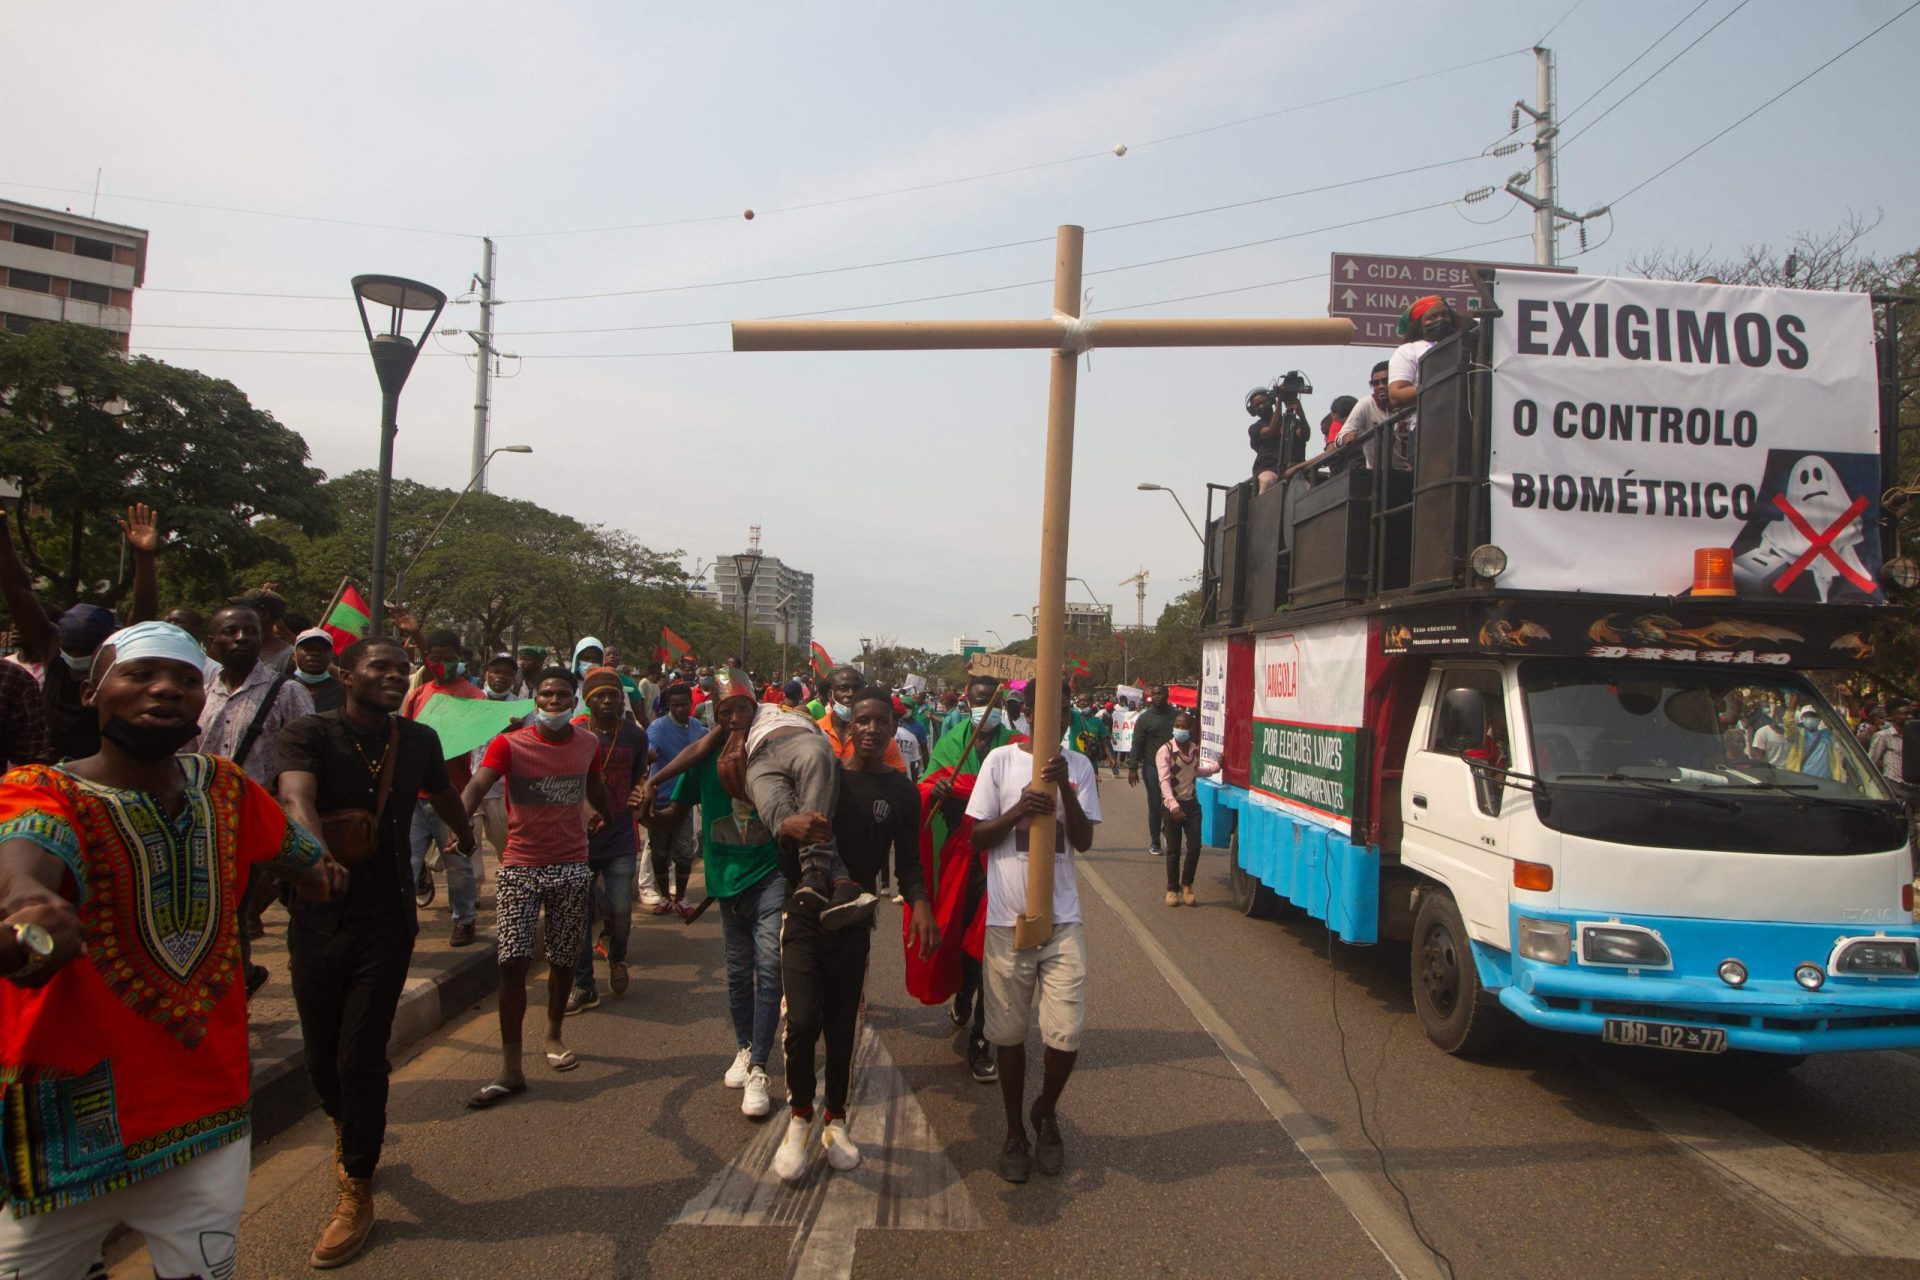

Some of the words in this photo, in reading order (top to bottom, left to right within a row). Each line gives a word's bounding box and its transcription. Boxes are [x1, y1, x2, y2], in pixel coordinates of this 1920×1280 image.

[1367, 263, 1417, 281] CIDA.
[1517, 299, 1809, 370] EXIGIMOS
[1513, 399, 1538, 437] O
[1553, 401, 1758, 448] CONTROLO
[1512, 469, 1756, 521] BIOMÉTRICO
[1266, 661, 1297, 698] ANGOLA
[1262, 727, 1278, 757] POR
[1279, 729, 1312, 765] ELEIÇÕES
[529, 776, 580, 793] Always
[1283, 770, 1289, 793] E
[1290, 771, 1344, 810] TRANSPARENTES
